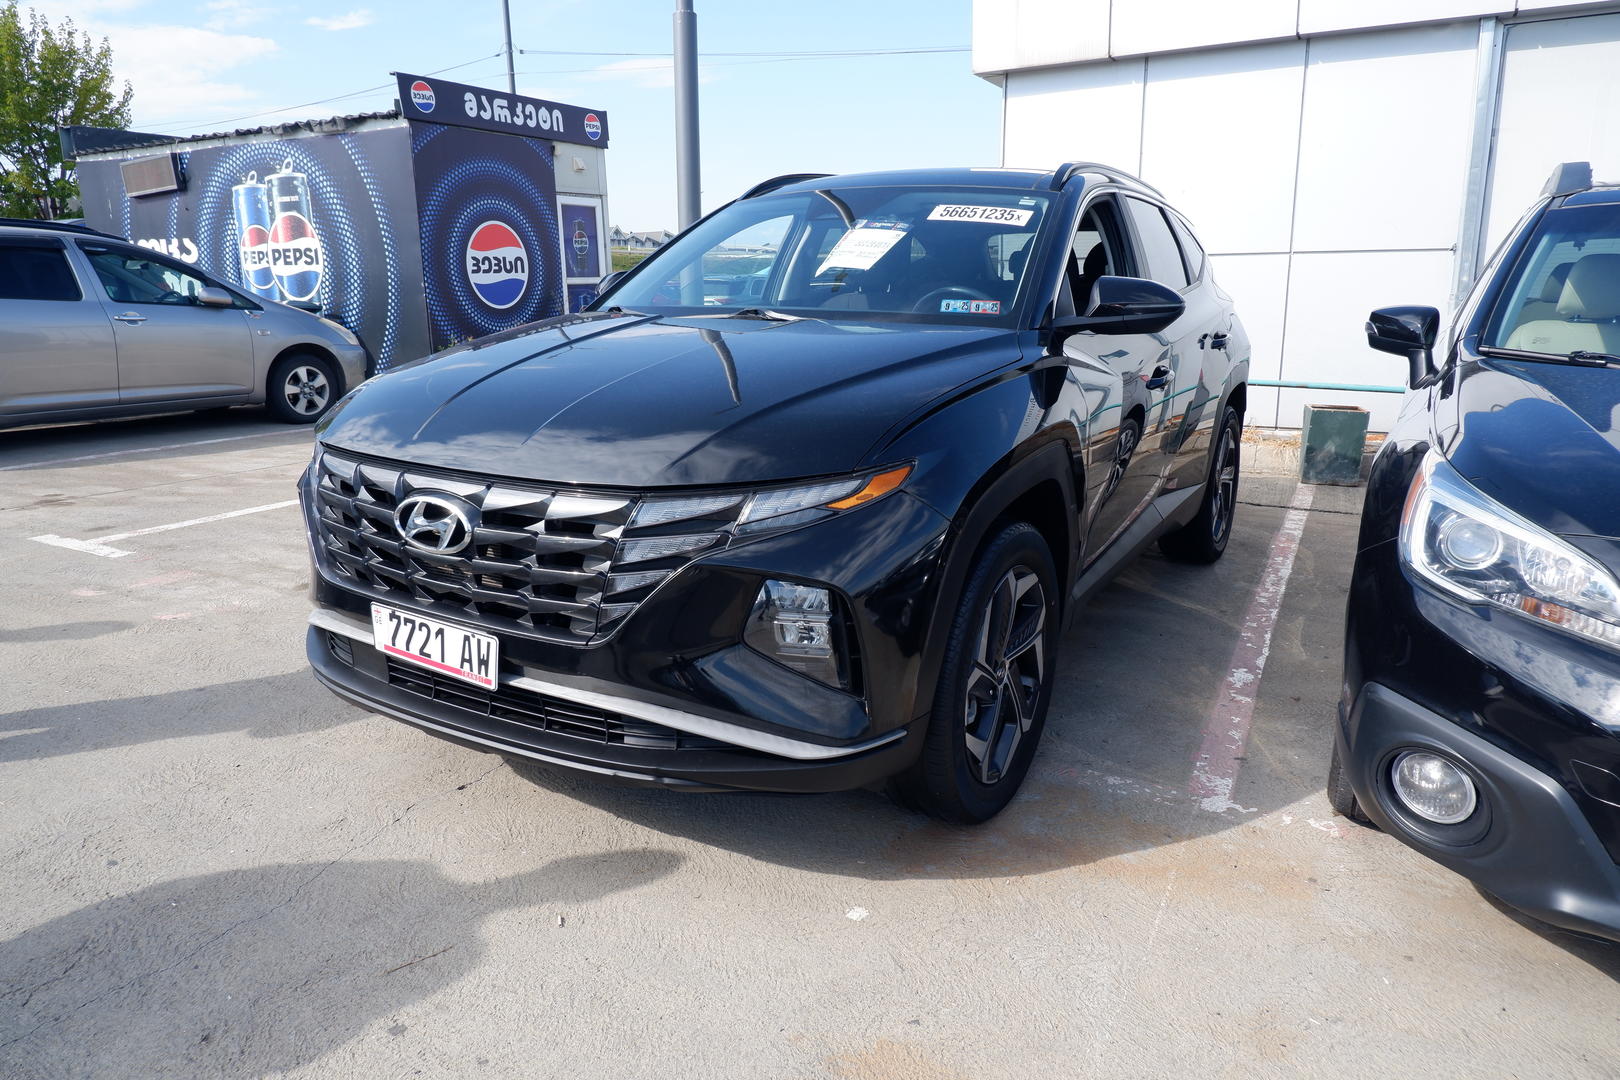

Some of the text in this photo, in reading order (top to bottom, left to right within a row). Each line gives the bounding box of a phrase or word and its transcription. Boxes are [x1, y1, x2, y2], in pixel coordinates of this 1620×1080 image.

[464, 92, 564, 132] მარკეტი
[585, 122, 600, 131] PEPSI
[243, 250, 269, 265] PEP
[271, 247, 320, 266] PEPSI
[389, 611, 491, 678] 7721 AW
